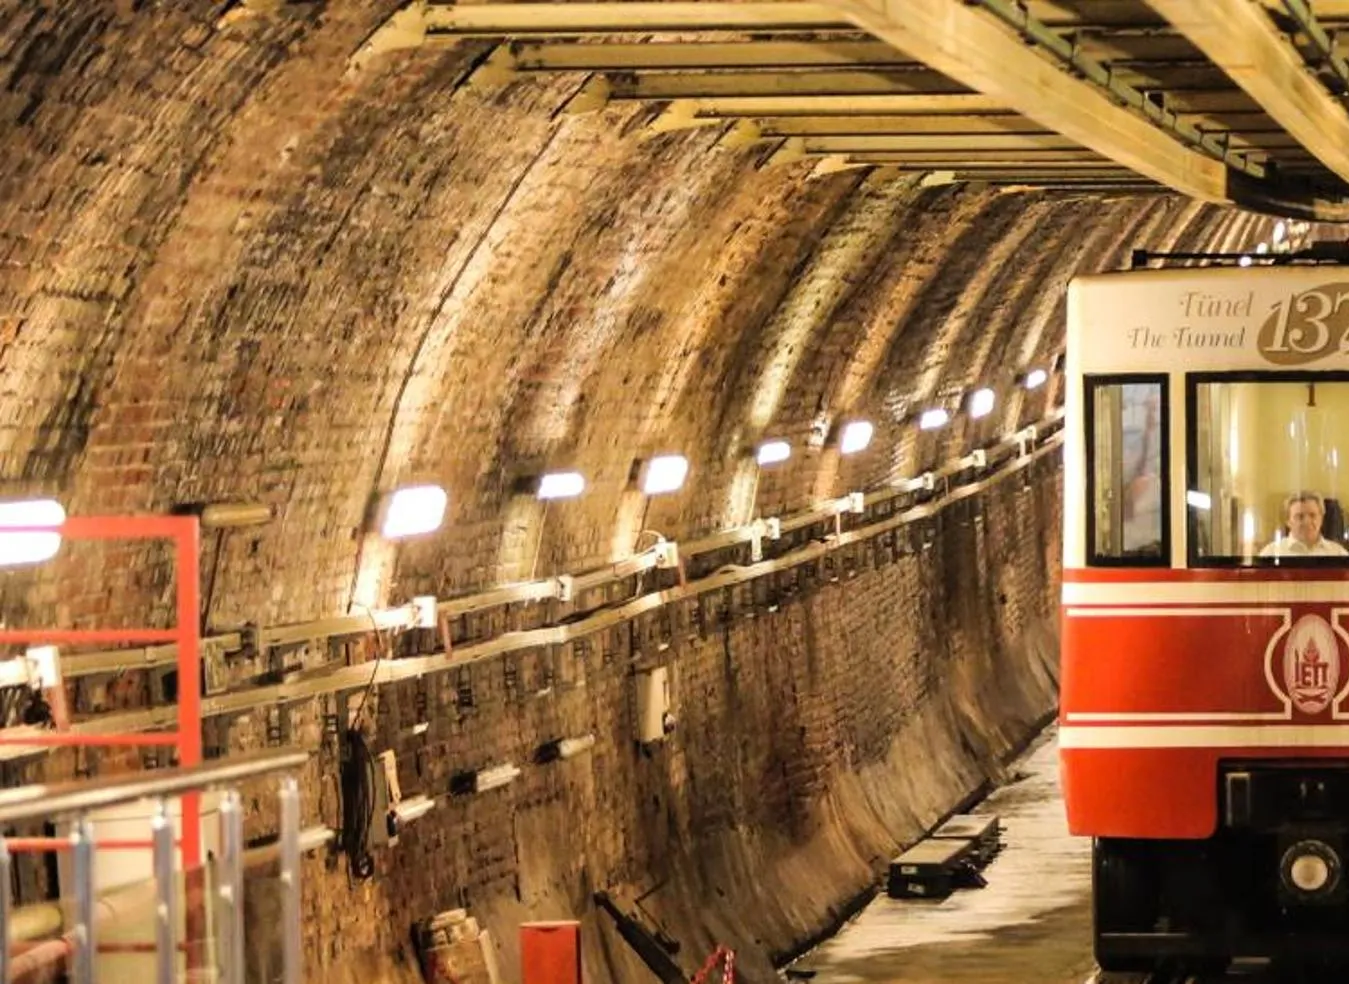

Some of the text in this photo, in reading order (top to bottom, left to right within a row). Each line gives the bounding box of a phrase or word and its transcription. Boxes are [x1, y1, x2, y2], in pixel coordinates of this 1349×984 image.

[1180, 290, 1254, 317] Tünel
[1128, 327, 1164, 348] The
[1173, 325, 1246, 347] Tunnel
